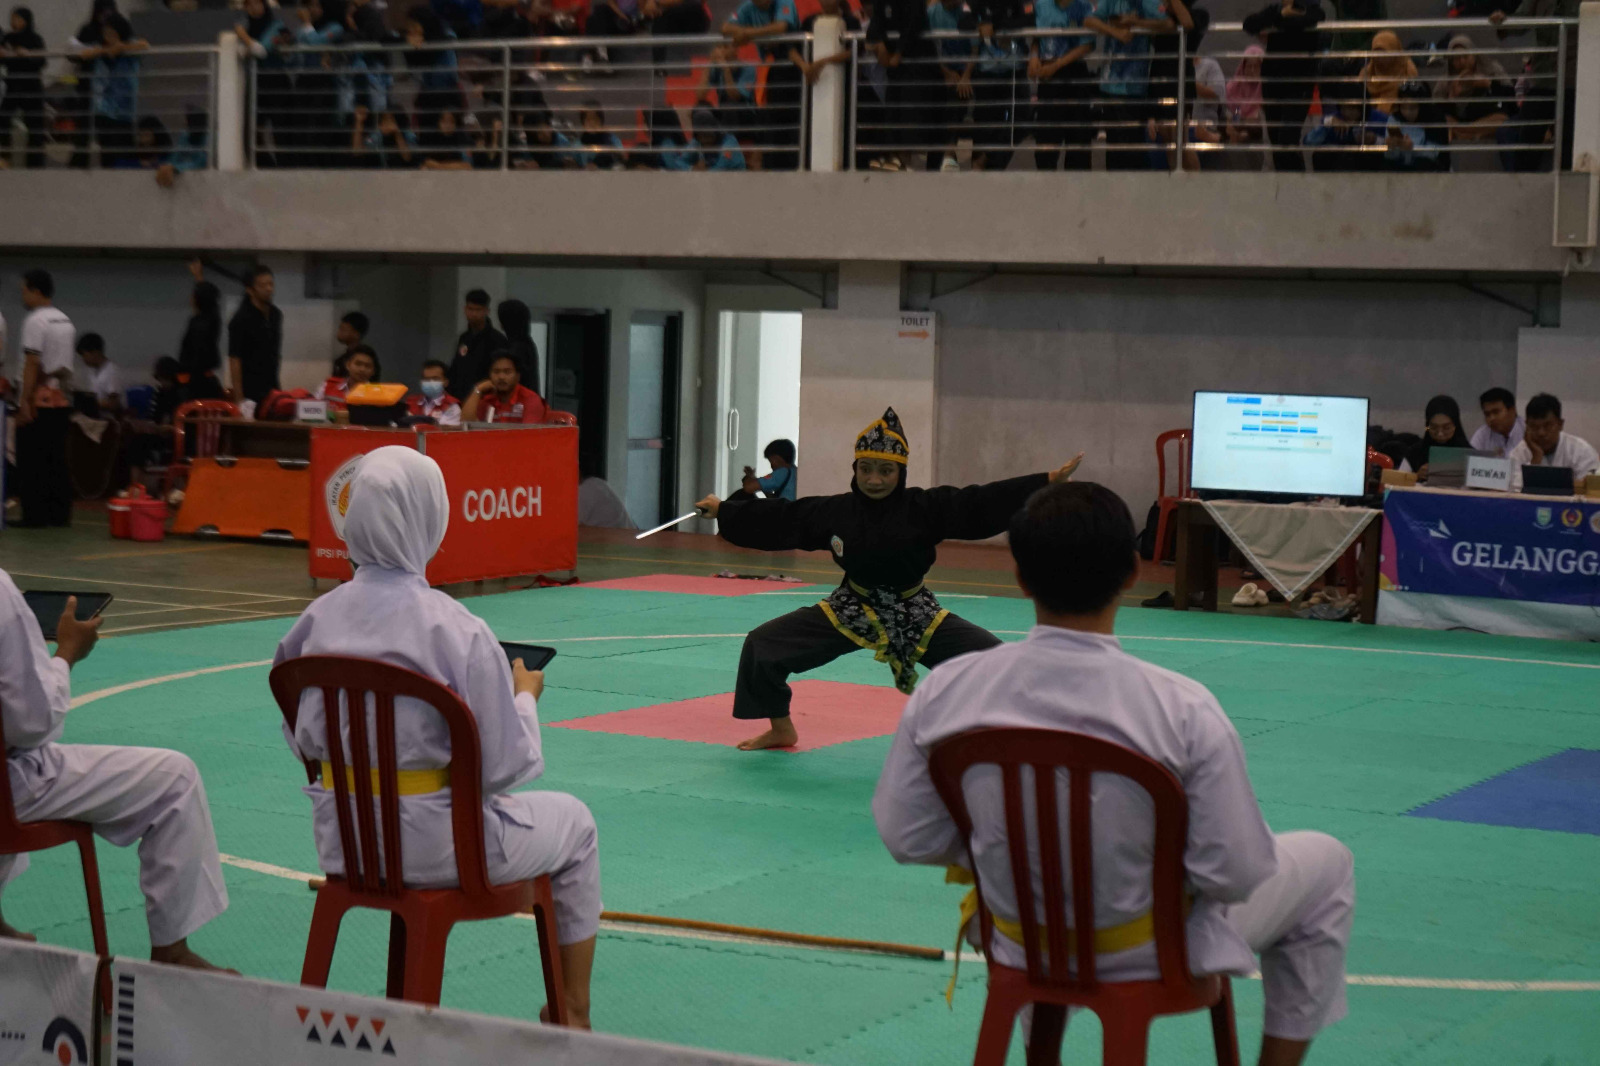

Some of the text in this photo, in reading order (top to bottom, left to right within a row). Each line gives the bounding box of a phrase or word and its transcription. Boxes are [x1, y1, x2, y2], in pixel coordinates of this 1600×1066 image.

[901, 317, 929, 326] TOILET
[1471, 468, 1506, 480] DEWAN
[331, 482, 341, 506] IKATAN
[463, 486, 542, 522] COACH
[317, 548, 334, 559] IPSI
[1452, 541, 1600, 575] GELANGG
